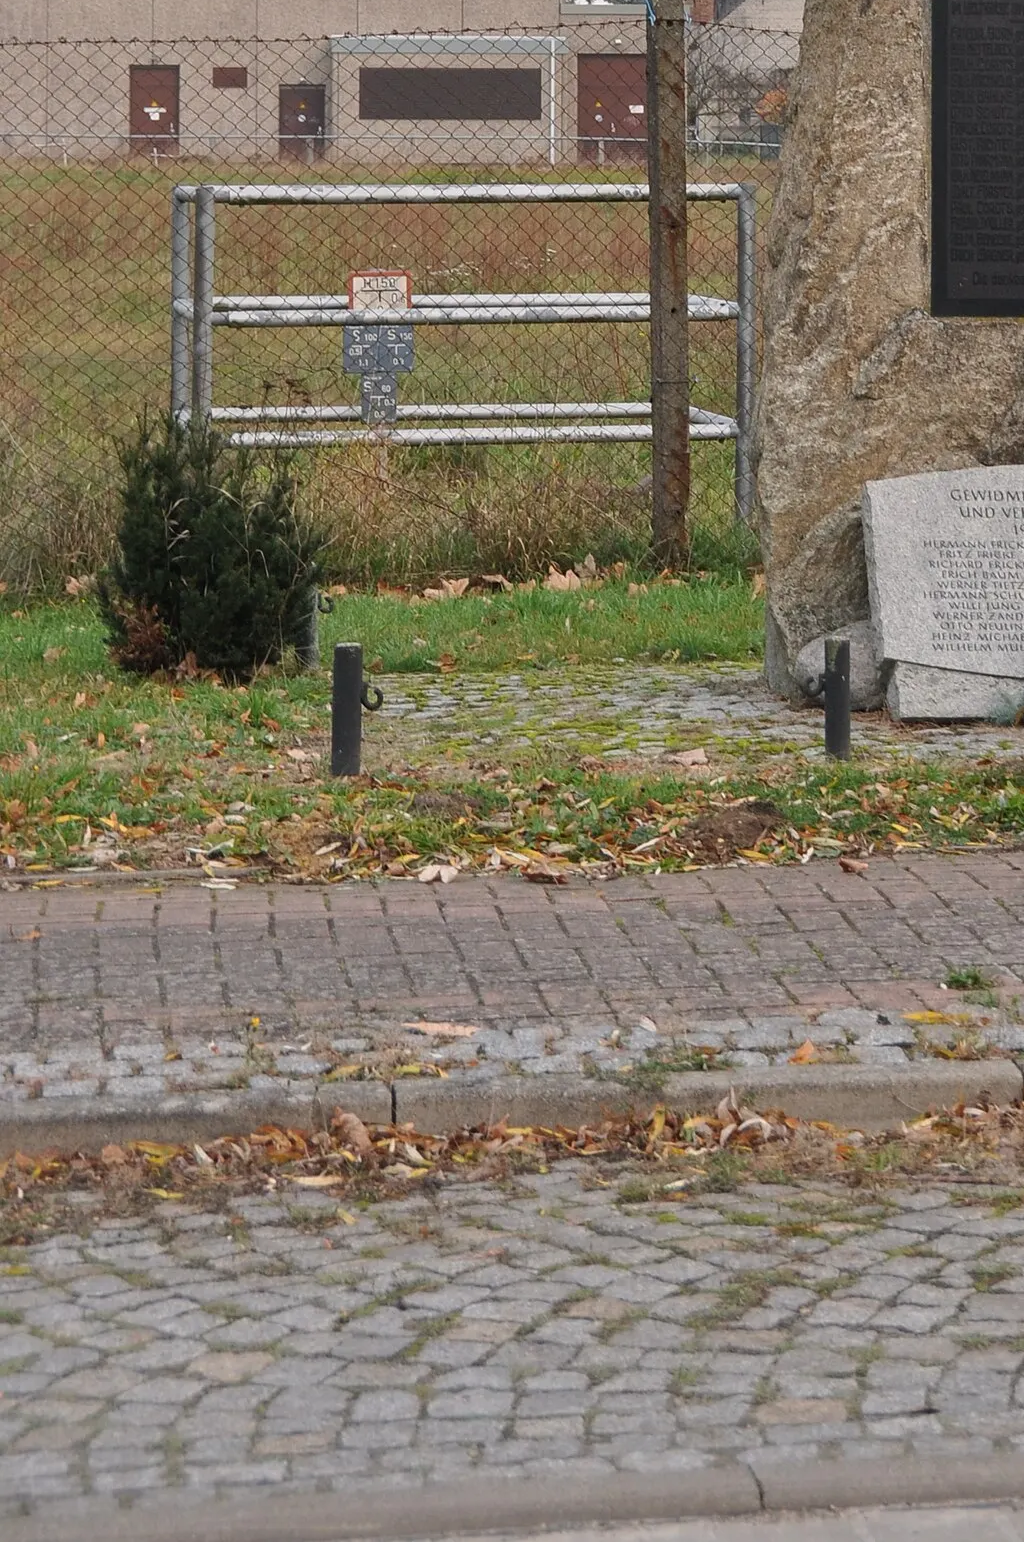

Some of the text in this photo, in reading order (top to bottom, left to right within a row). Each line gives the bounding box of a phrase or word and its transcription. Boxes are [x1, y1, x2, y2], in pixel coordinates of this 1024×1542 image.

[352, 329, 361, 342] S
[387, 329, 396, 340] S
[363, 380, 372, 392] S
[959, 506, 995, 519] UND
[923, 540, 986, 548] HERMANN
[940, 550, 972, 558] FRITZ
[928, 560, 983, 568] RICHARD
[941, 570, 1020, 579] ERICH BAUM
[936, 581, 1024, 589] WERNER TIETZ
[923, 591, 987, 599] HERMANN
[948, 601, 1020, 611] WILLI JUNG
[932, 611, 984, 619] WERNER
[940, 622, 974, 630] OTTO
[932, 632, 970, 641] HEINZ
[932, 643, 992, 652] WILHELM
